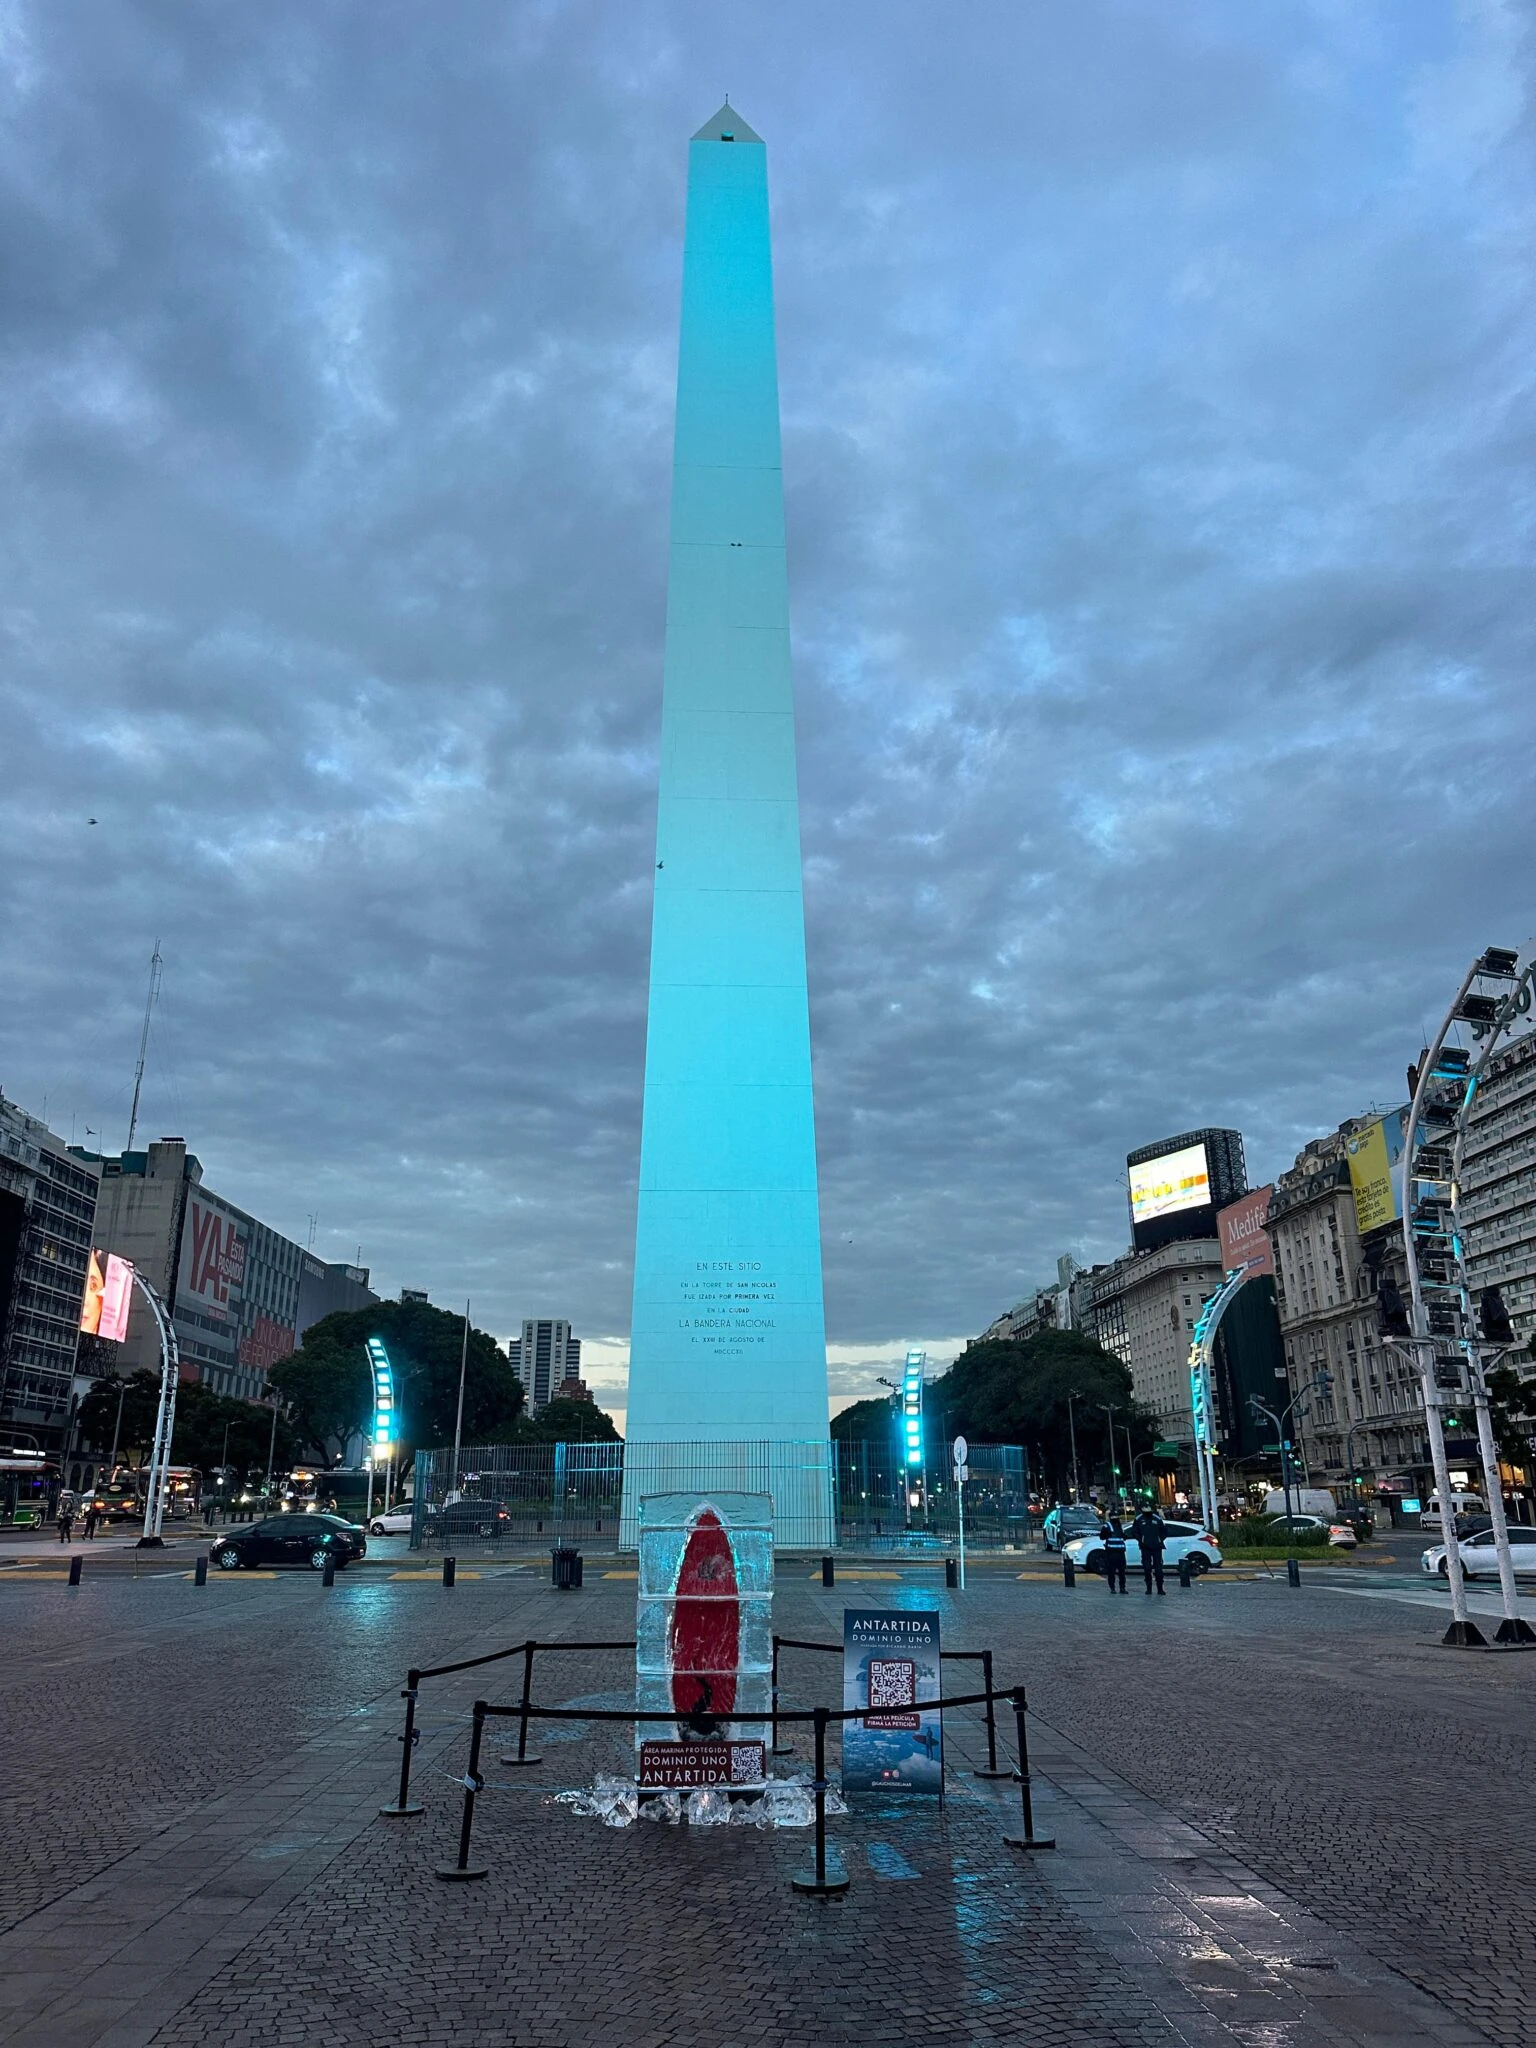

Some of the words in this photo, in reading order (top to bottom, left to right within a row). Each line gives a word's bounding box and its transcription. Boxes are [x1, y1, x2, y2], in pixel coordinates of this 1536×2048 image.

[1355, 1188, 1361, 1196] Te
[1361, 1185, 1370, 1194] soy
[1357, 1196, 1366, 1205] esta
[1367, 1188, 1382, 1200] tarjeta
[1383, 1184, 1389, 1194] de
[1227, 1204, 1265, 1243] Medifé
[218, 1255, 243, 1282] PASANDO
[739, 1262, 761, 1270] SITIO
[852, 1634, 901, 1642] DOMINIO
[908, 1636, 931, 1644] UNO
[644, 1756, 697, 1766] DOMINIO
[702, 1756, 727, 1766] UNO
[643, 1768, 728, 1782] ANTÁRTIDA
